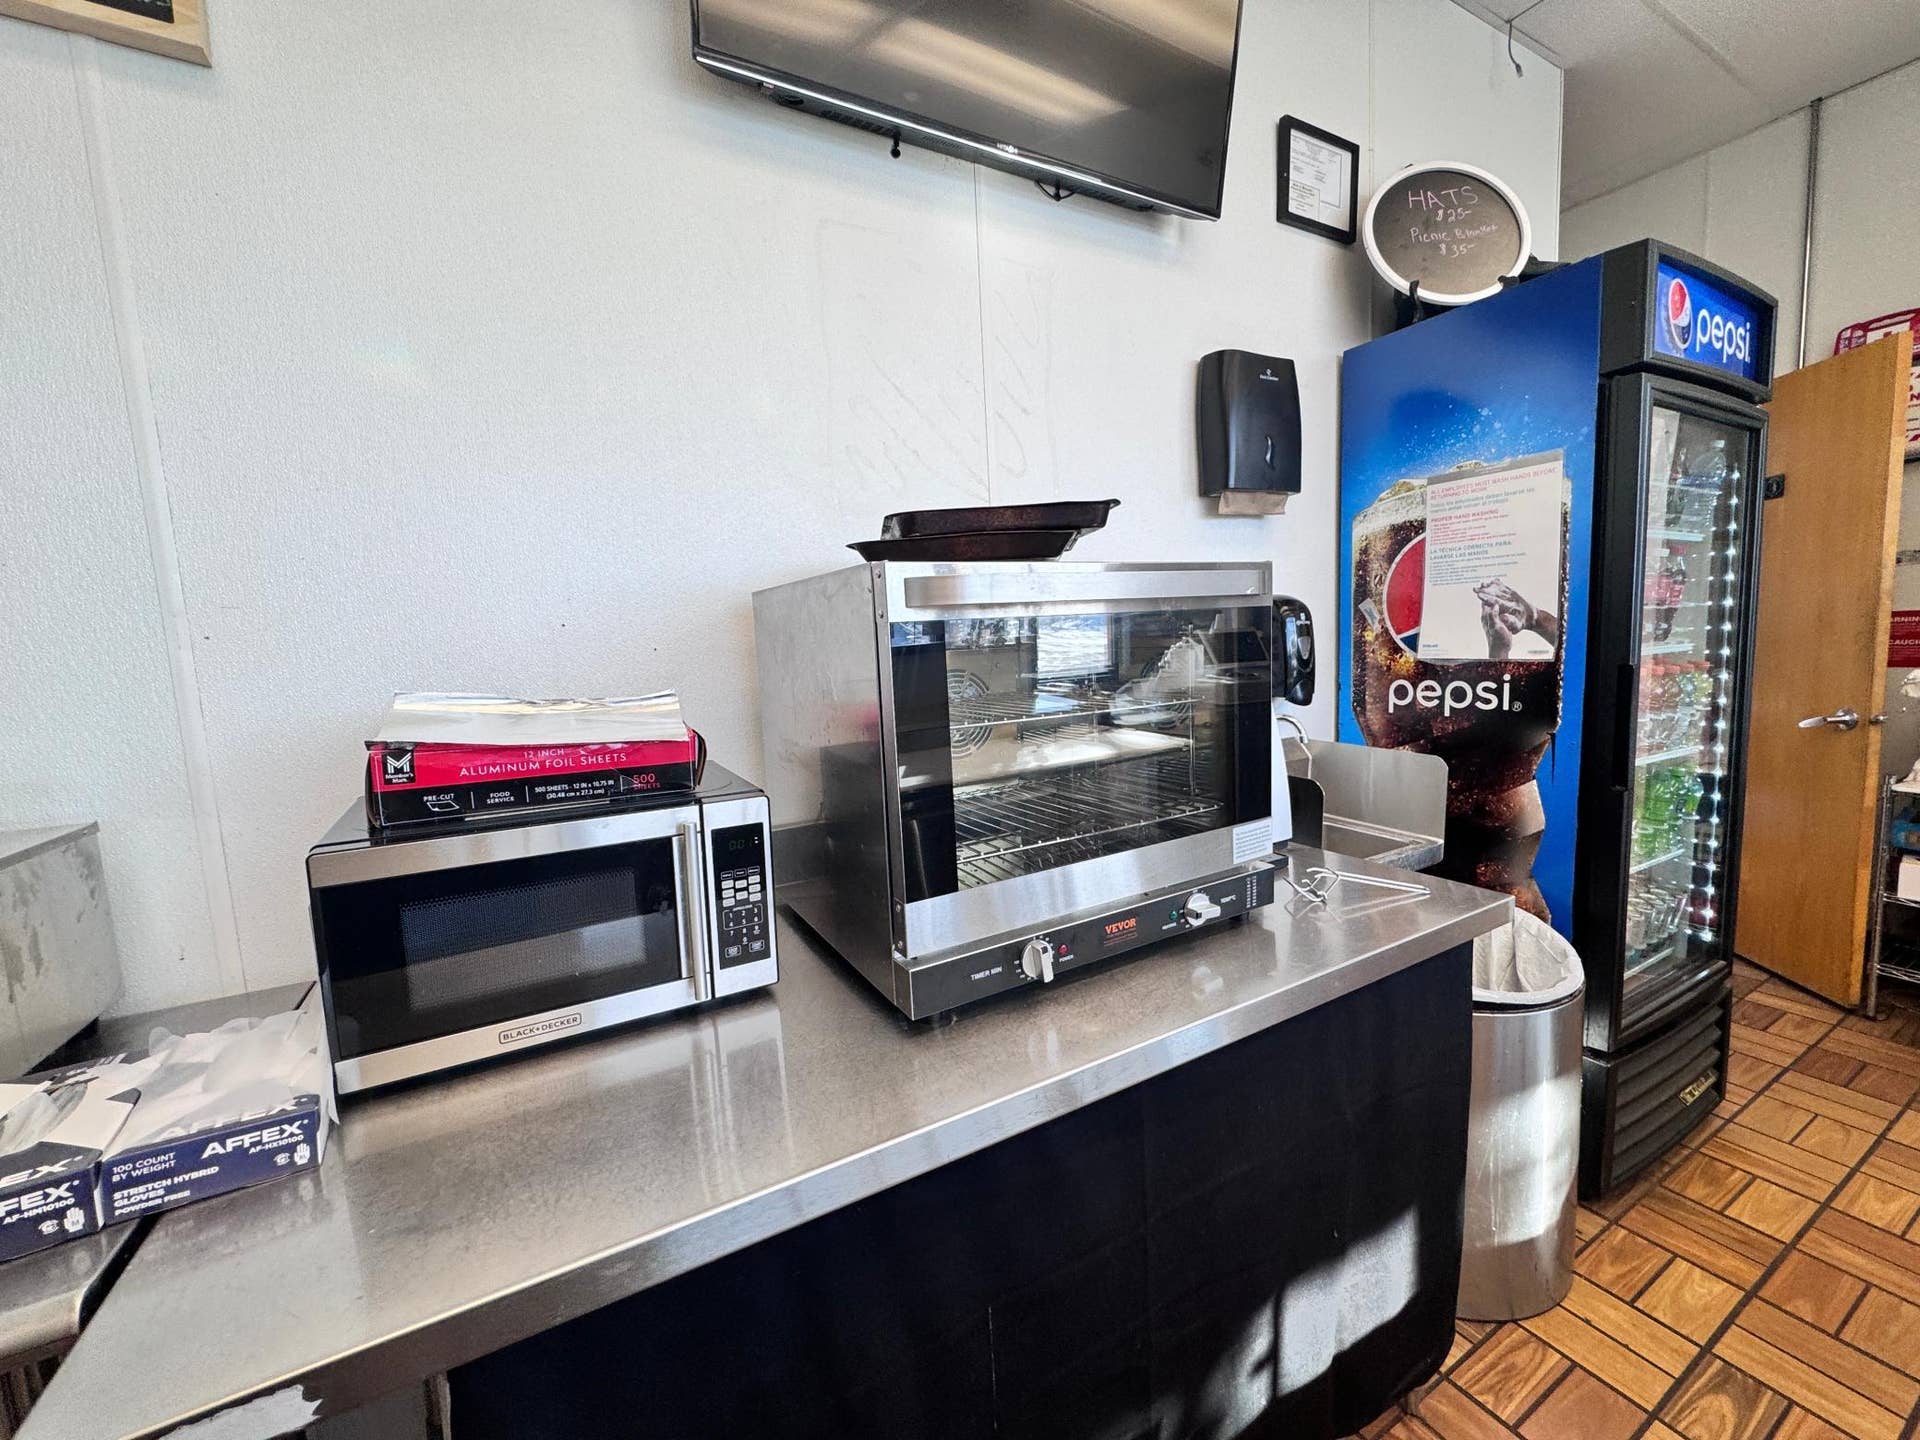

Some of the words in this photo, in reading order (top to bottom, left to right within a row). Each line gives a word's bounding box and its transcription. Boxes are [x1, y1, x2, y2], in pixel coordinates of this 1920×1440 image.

[1408, 186, 1478, 210] HATS
[1410, 227, 1450, 243] Picnic
[1696, 309, 1750, 364] pepsi
[1388, 673, 1512, 717] pepsi
[539, 748, 565, 757] INCH
[459, 761, 540, 777] ALUMINUM
[545, 757, 576, 768] FOIL
[580, 753, 627, 766] SHEETS
[546, 784, 569, 792] SHEETS
[633, 773, 656, 784] 500
[423, 793, 455, 802] PRE-CUT
[486, 796, 515, 804] SERVICE
[1104, 918, 1137, 934] VEVOR
[970, 970, 990, 981] TIMER
[502, 1016, 578, 1041] BLACK+DECKER
[201, 1120, 303, 1159] AFFEX
[112, 1163, 133, 1175] 100
[136, 1152, 176, 1169] COUNT
[112, 1173, 129, 1182] BY
[131, 1160, 176, 1178] WEIGHT
[113, 1179, 172, 1200] STRETCH
[174, 1166, 219, 1185] HYBRID
[0, 1182, 73, 1217] FEX
[113, 1189, 166, 1208] GLOVES
[114, 1199, 162, 1216] POWDER
[164, 1190, 191, 1203] FREE
